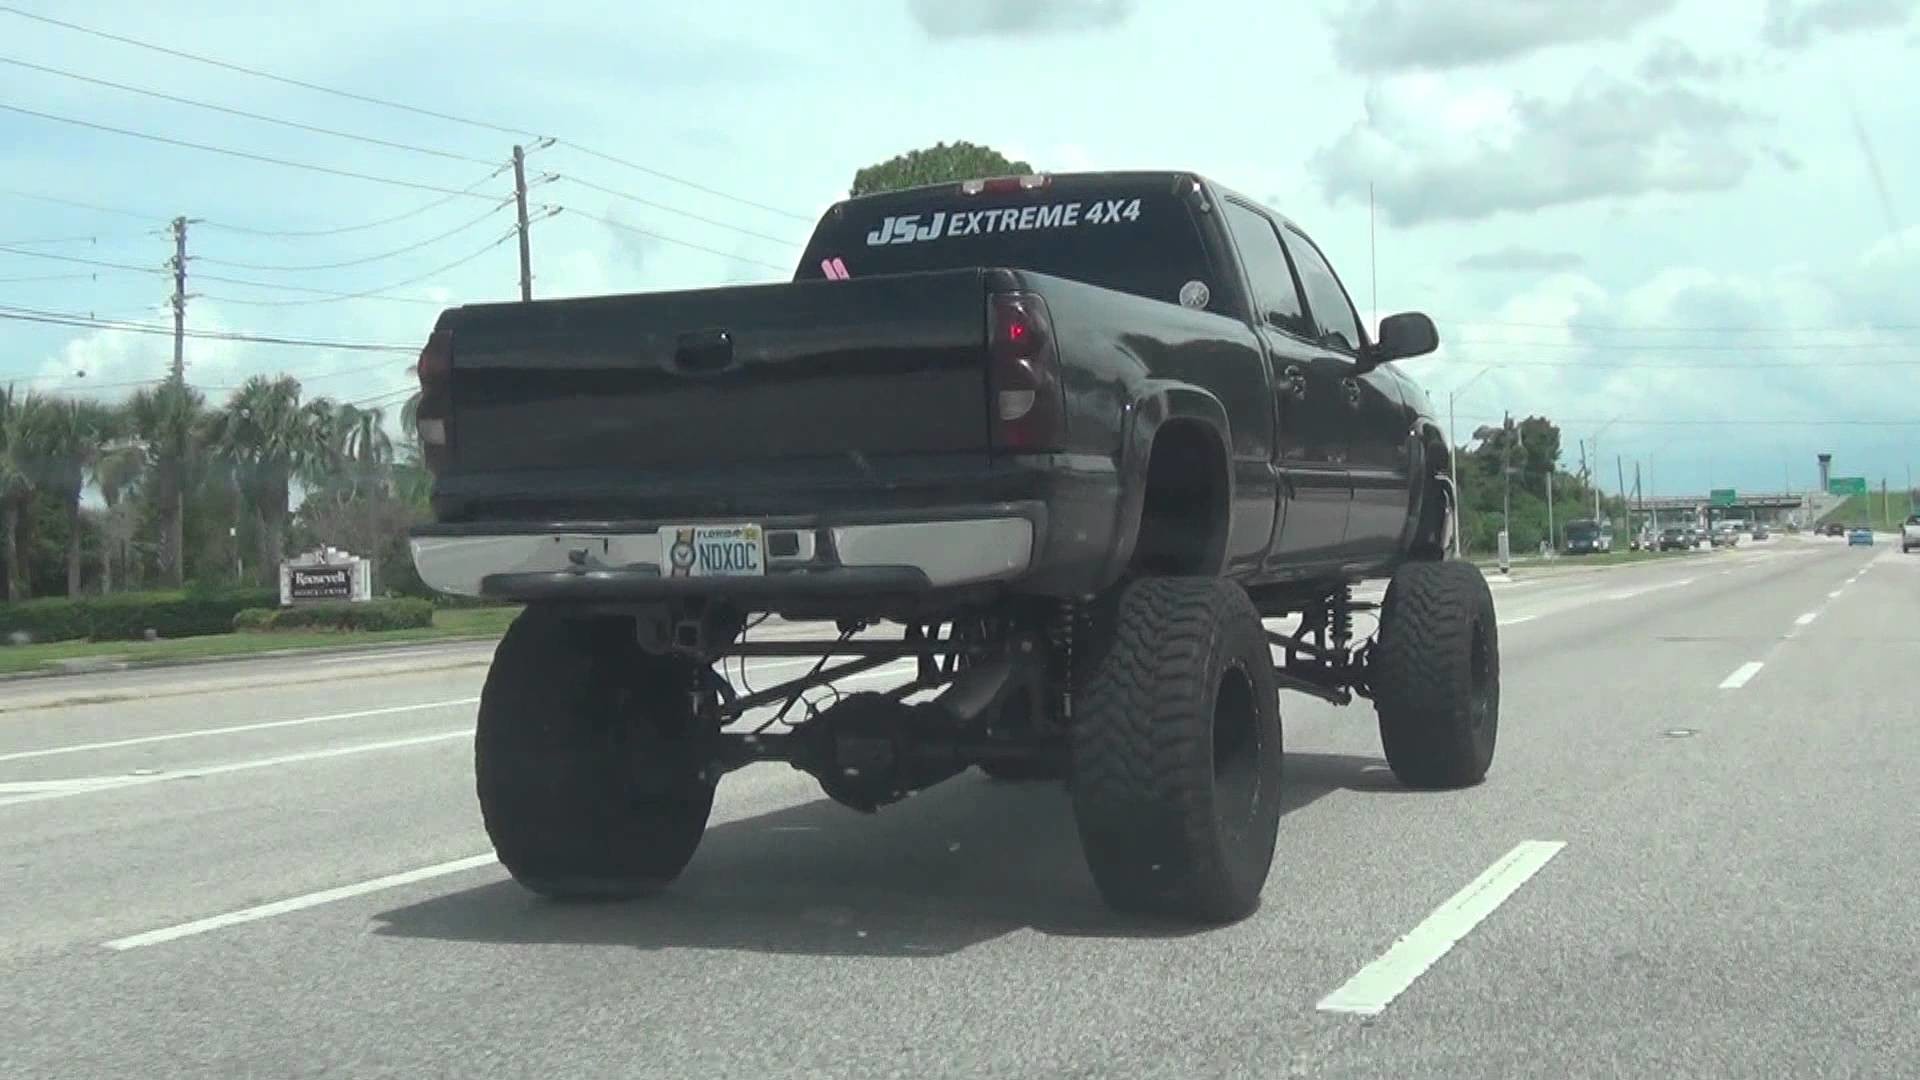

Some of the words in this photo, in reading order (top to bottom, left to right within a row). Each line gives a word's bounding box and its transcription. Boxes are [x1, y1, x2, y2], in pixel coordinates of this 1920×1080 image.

[867, 213, 945, 246] JSJ
[948, 203, 1081, 236] EXTREME
[1085, 199, 1141, 224] 4X4
